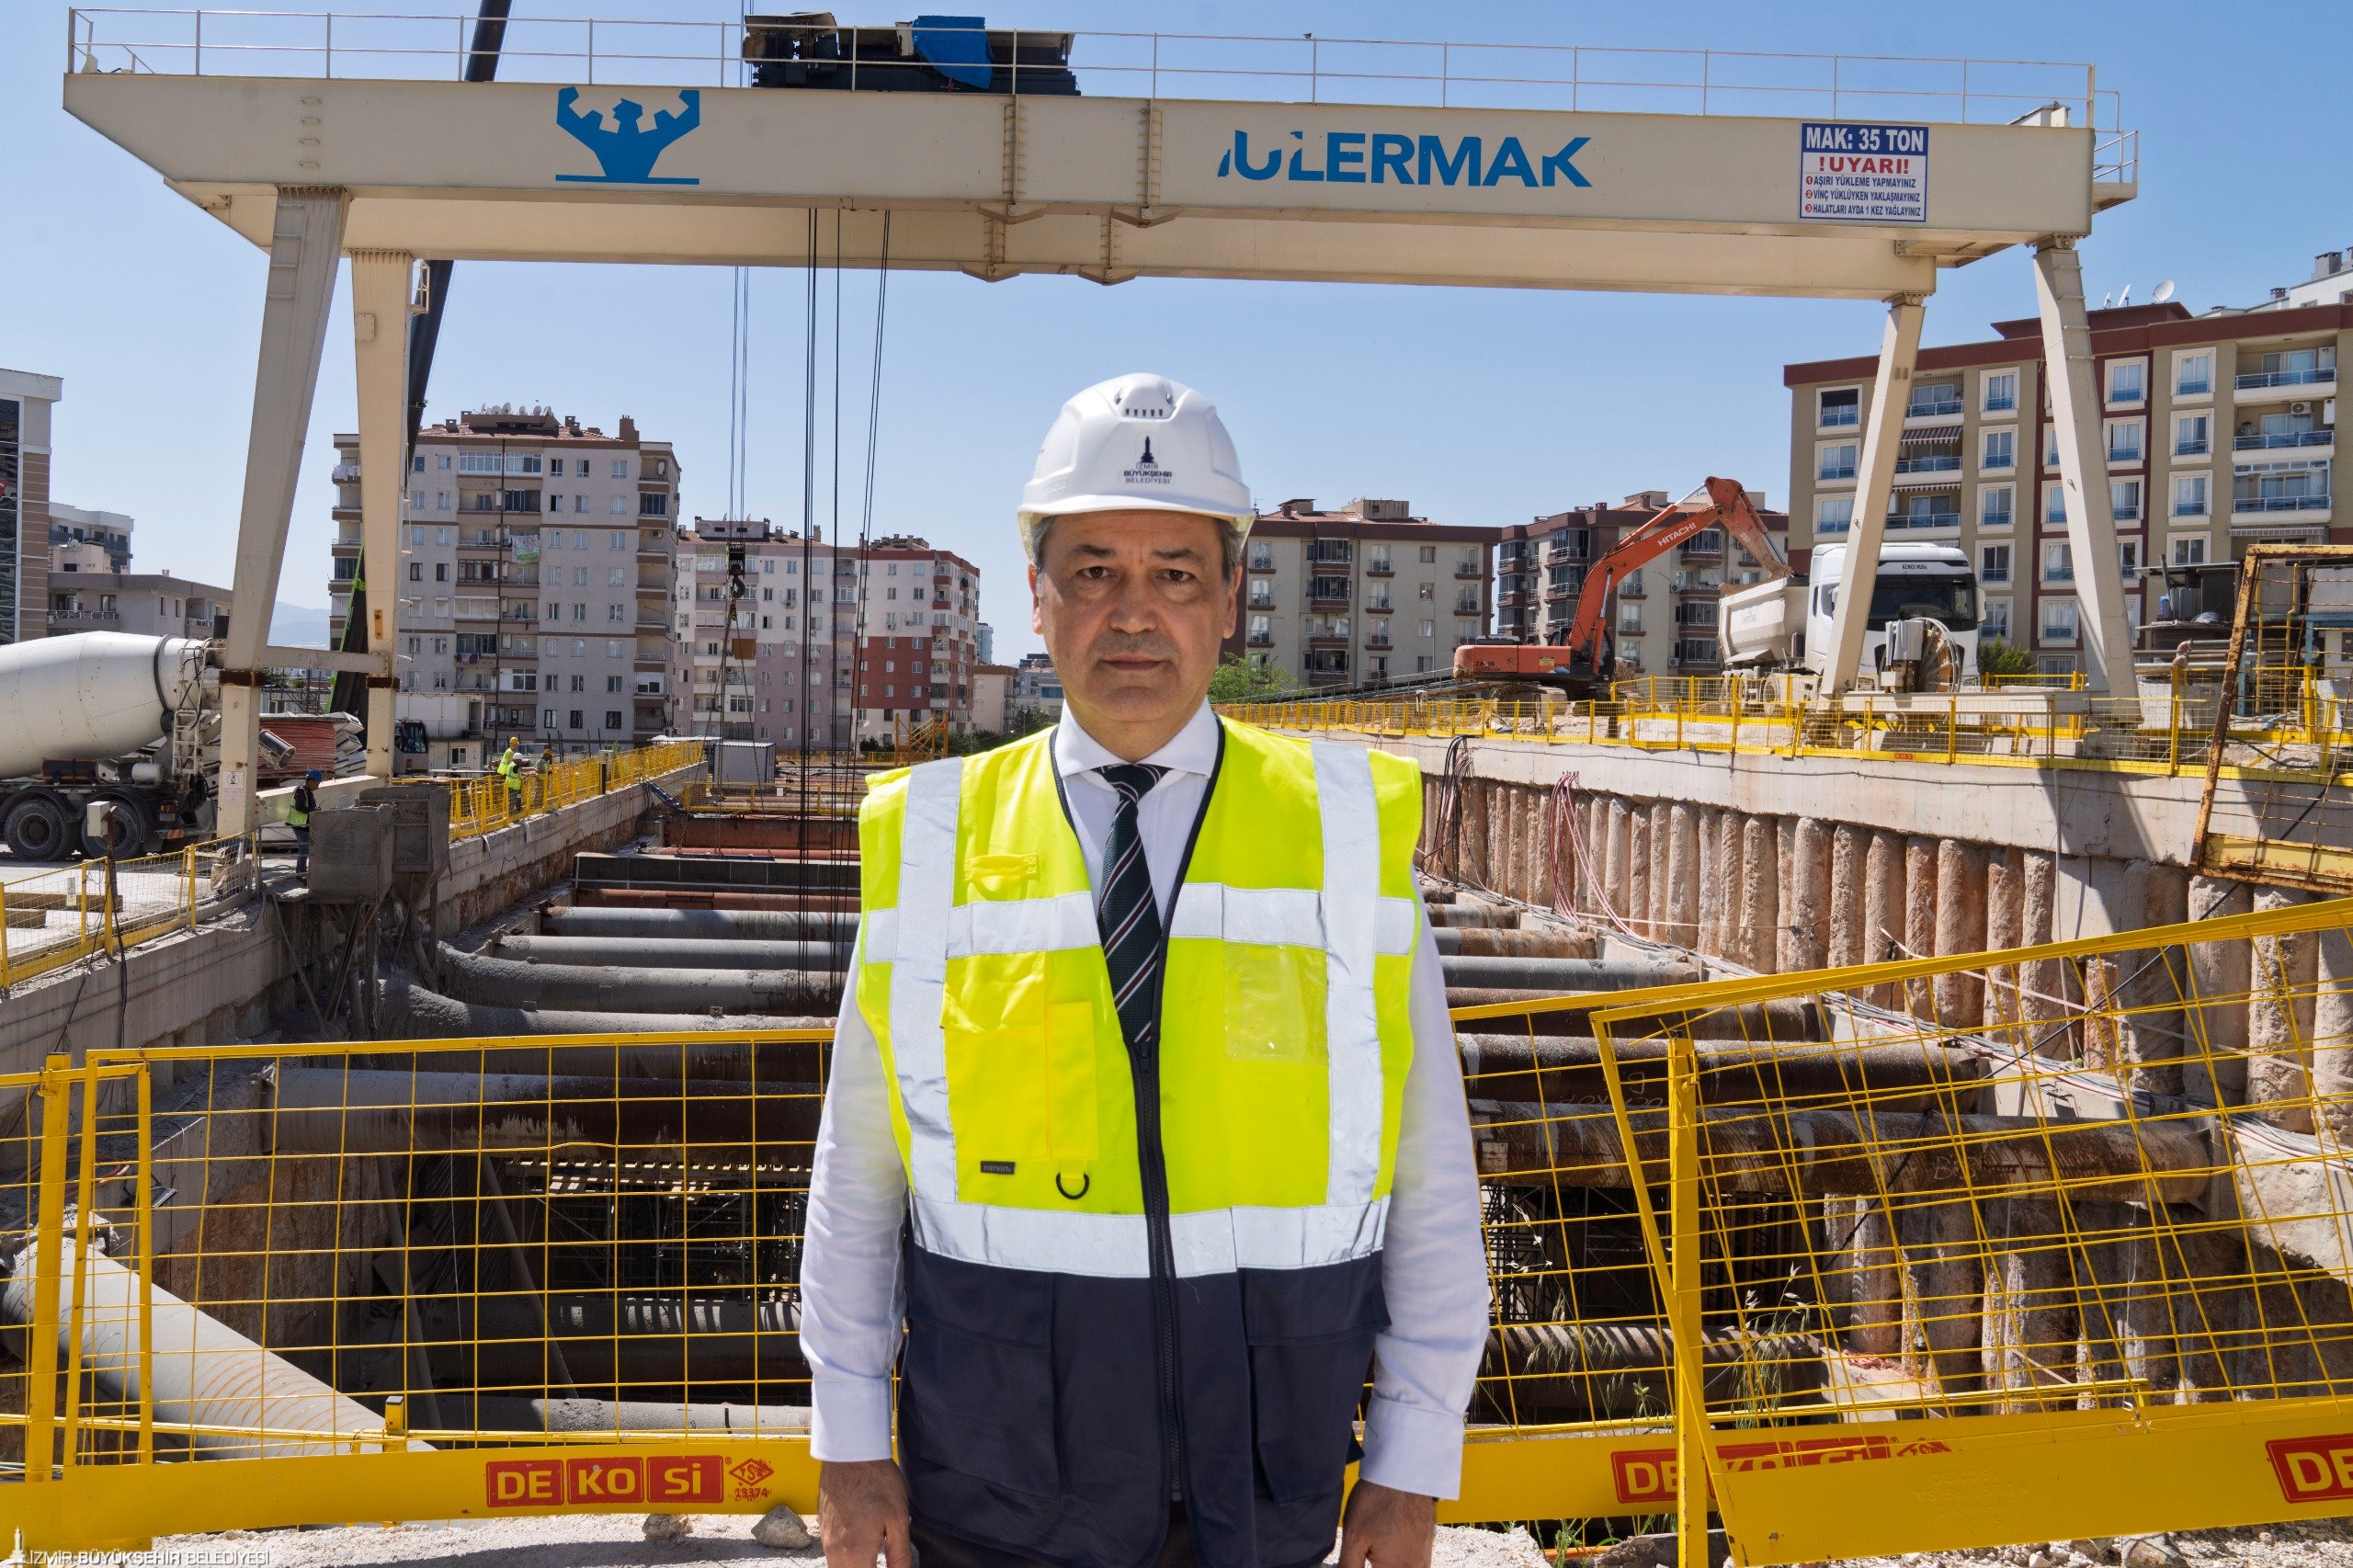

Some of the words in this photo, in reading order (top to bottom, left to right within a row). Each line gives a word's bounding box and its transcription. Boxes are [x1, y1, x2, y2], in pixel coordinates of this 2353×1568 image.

[1806, 127, 1853, 150] MAK:
[1859, 128, 1881, 151] 35
[1885, 130, 1924, 153] TON
[1813, 176, 1834, 187] AŞIRI
[1835, 175, 1870, 187] YÜKLEME
[1871, 177, 1916, 188] YAPMAYINIZ
[1813, 187, 1829, 202] VİNÇ
[1830, 188, 1869, 200] YÜKLÜYKEN
[1870, 191, 1921, 203] YAKLAŞMAYINIZ
[1813, 203, 1847, 214] HALATLARI
[1847, 205, 1864, 215] AYDA
[1870, 205, 1883, 216] KEZ
[1884, 204, 1921, 217] YAĞLAYINIZ
[1657, 522, 1697, 547] HITACHI
[497, 1470, 553, 1501] DE
[578, 1468, 636, 1495] KO
